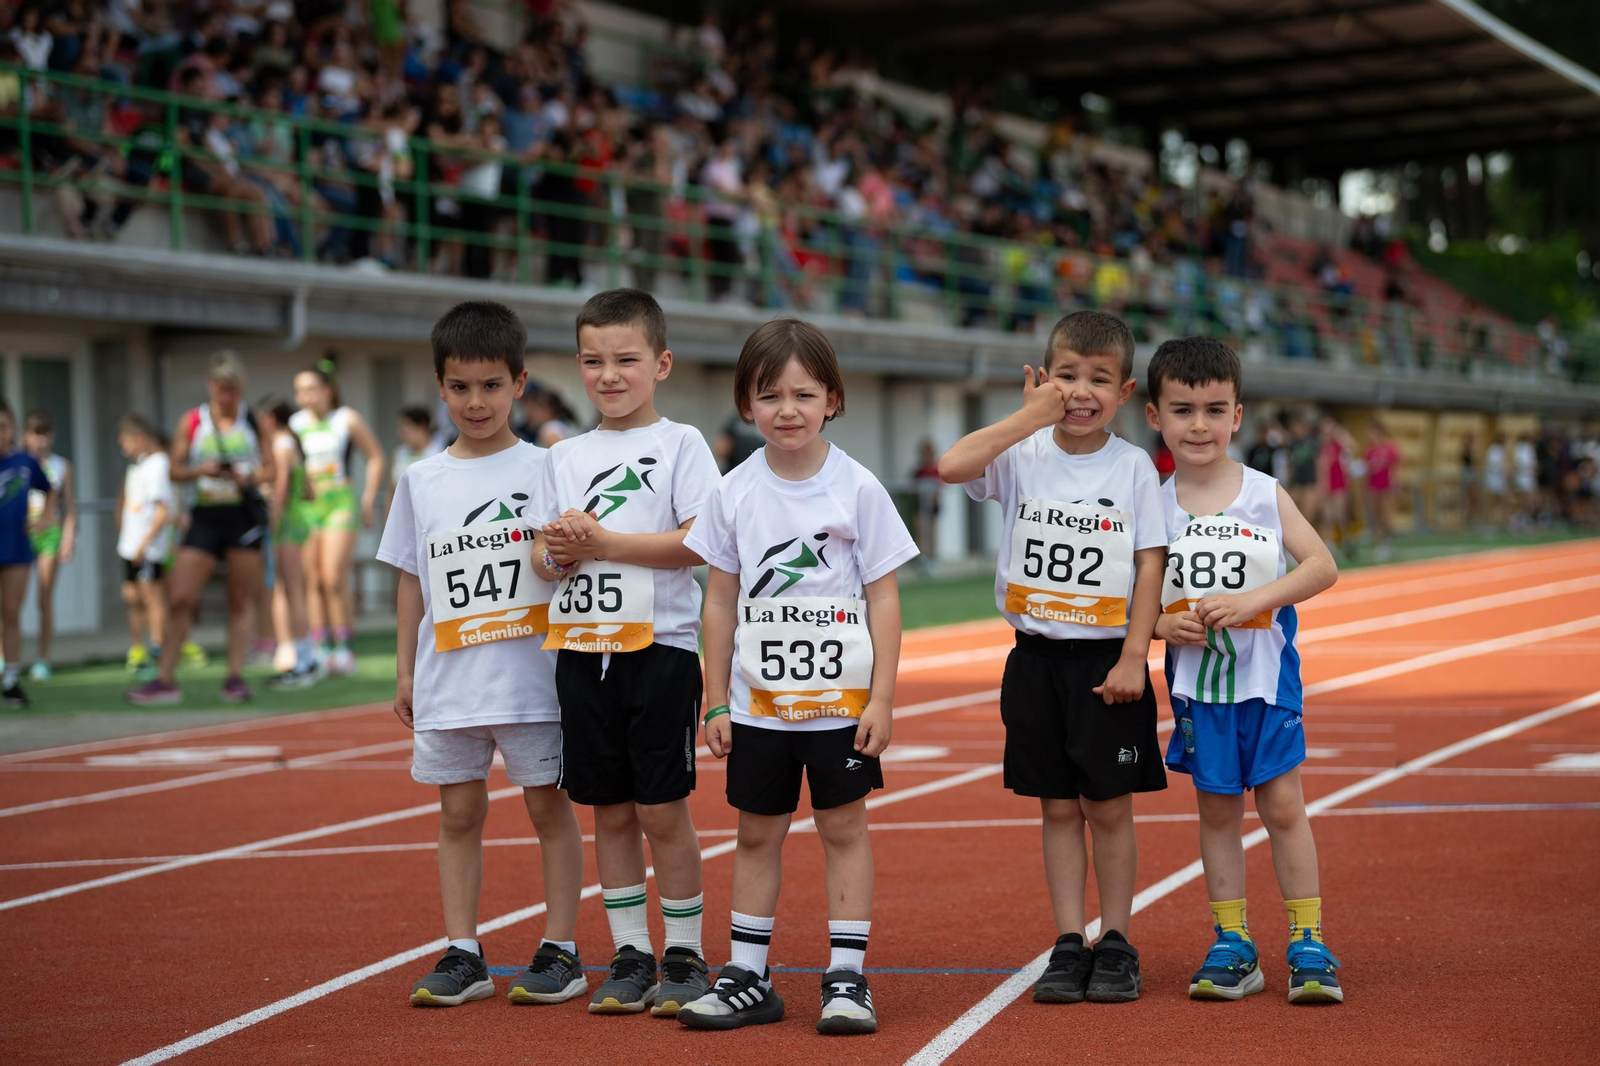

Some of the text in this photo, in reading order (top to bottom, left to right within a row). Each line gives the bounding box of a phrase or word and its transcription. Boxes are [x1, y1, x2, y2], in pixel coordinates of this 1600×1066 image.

[1019, 503, 1042, 523] La
[429, 541, 454, 559] La
[1023, 538, 1104, 587] 582
[1166, 551, 1247, 589] 383
[446, 559, 521, 609] 547
[743, 605, 775, 624] La
[1025, 603, 1098, 624] telemiño
[460, 623, 534, 646] telemiño
[563, 638, 623, 651] telemiño
[760, 640, 843, 681] 533
[775, 705, 850, 720] telemiño
